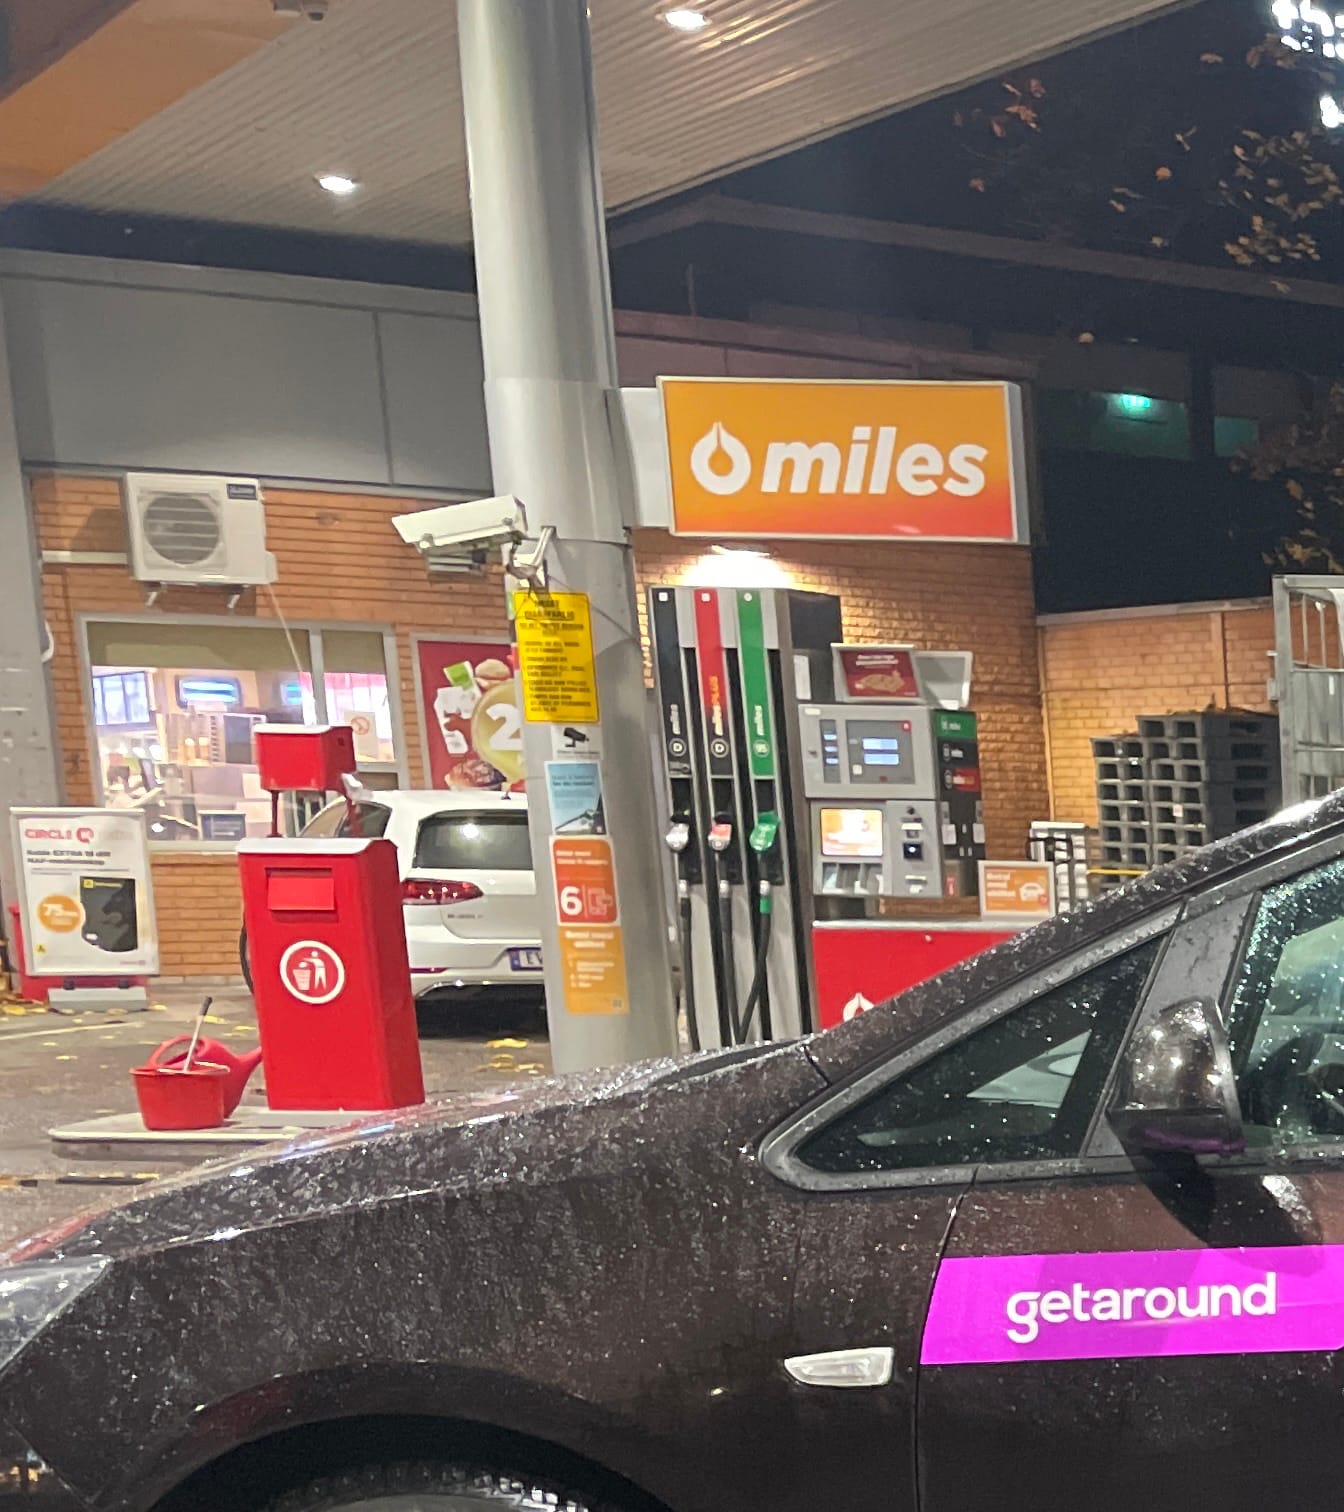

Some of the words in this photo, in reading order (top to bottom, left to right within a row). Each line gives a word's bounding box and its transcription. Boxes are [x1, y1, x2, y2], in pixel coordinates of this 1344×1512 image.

[761, 427, 988, 496] miles
[560, 886, 583, 916] 6
[1006, 1271, 1278, 1344] getaround
